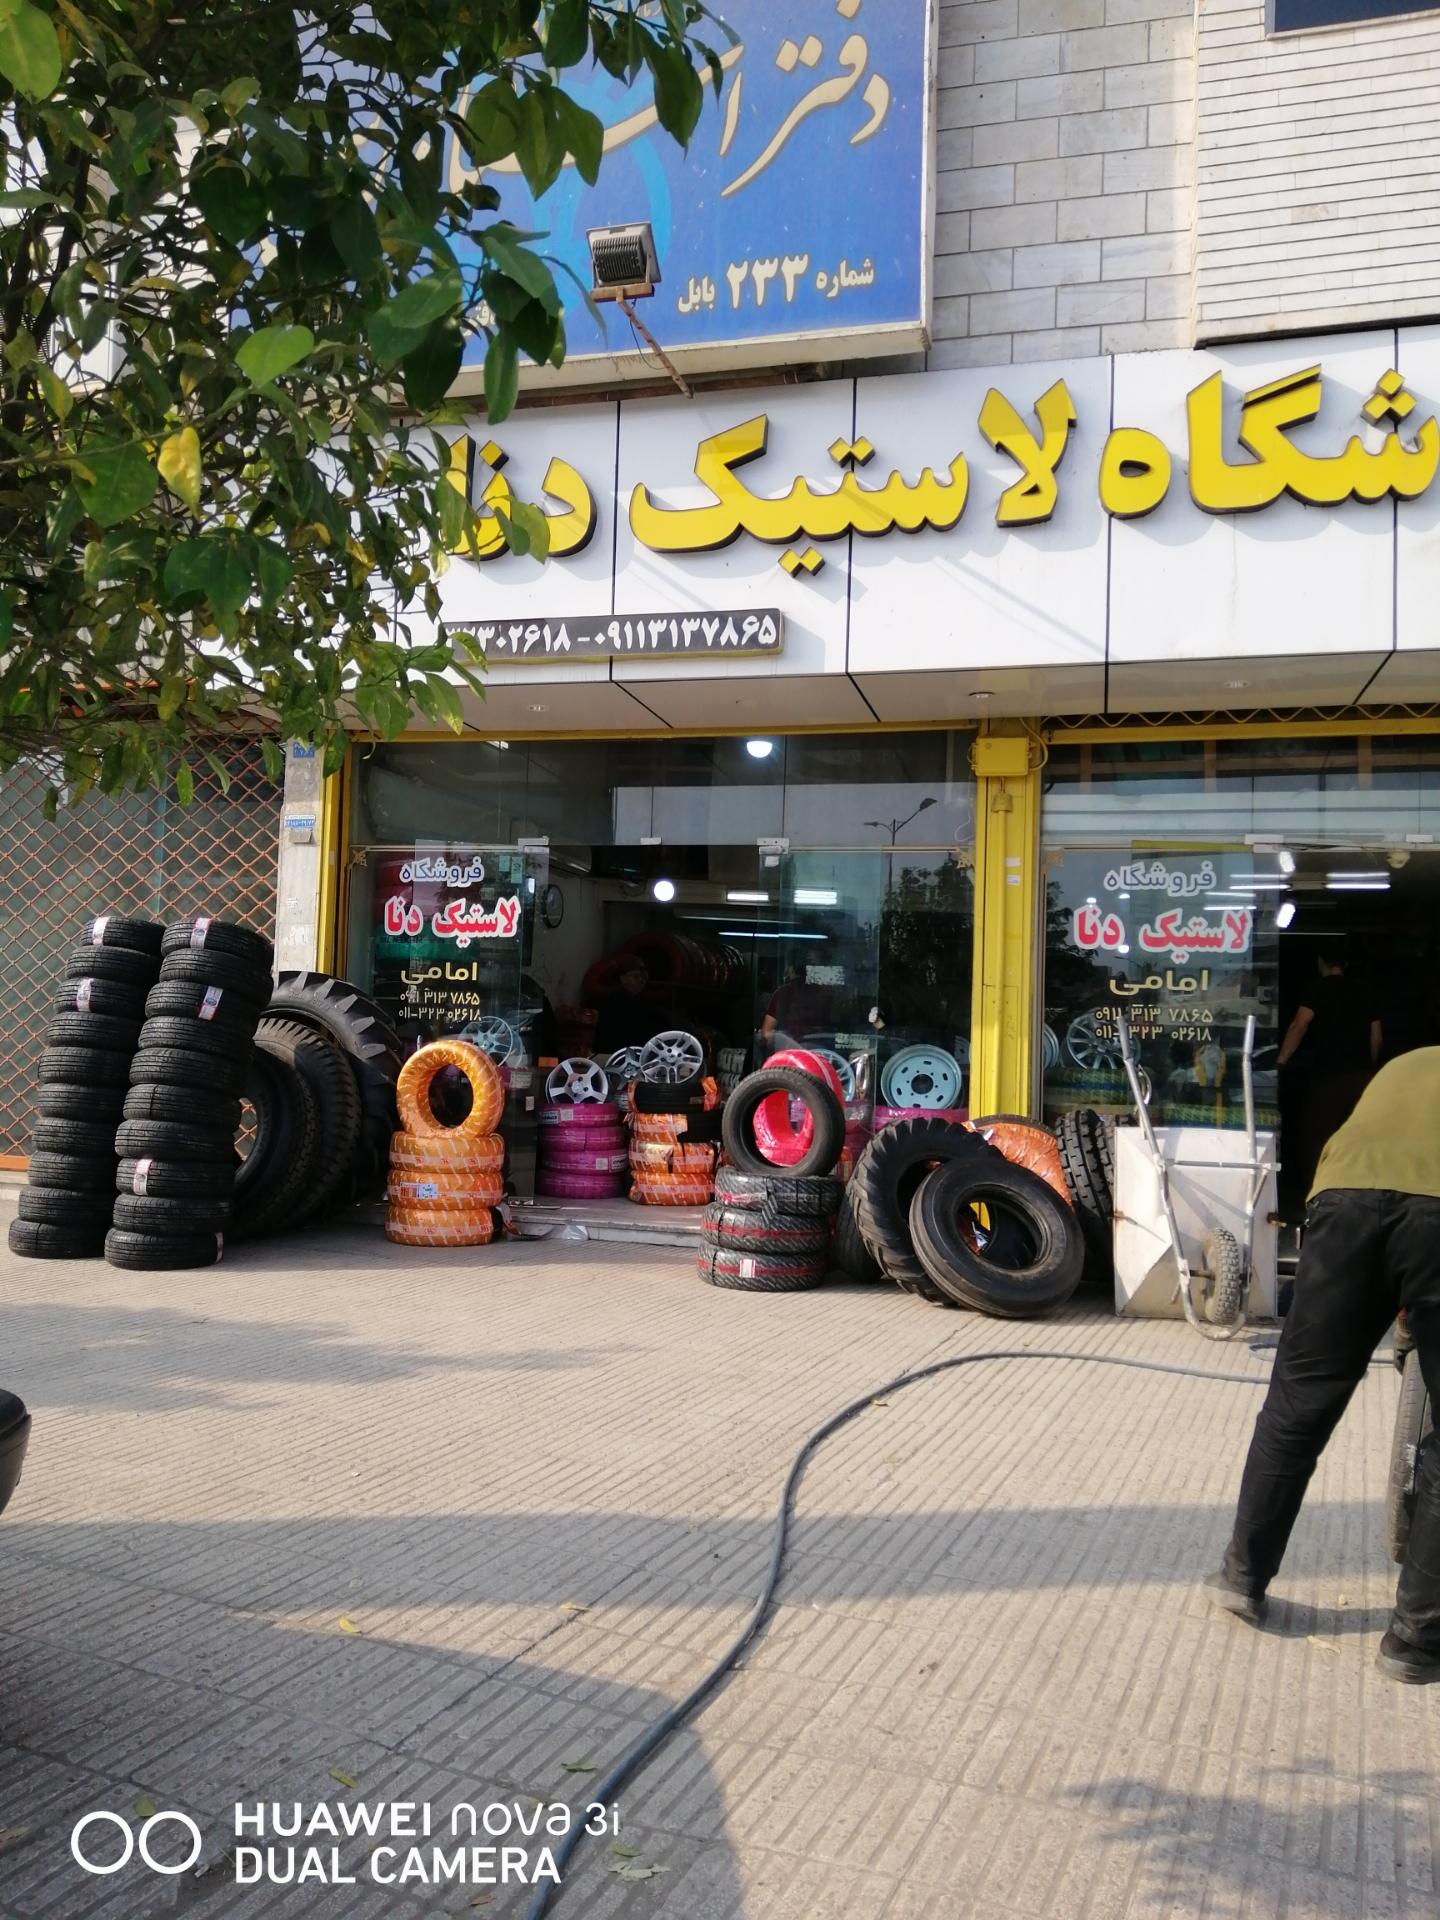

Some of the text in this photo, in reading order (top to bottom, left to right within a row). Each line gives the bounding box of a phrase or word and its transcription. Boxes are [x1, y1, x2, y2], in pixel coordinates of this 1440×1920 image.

[721, 0, 891, 198] دفتر
[678, 275, 715, 314] بابل
[815, 257, 875, 303] شماره
[629, 378, 1078, 578] لاستیک
[399, 855, 485, 888] فروشگاه
[1104, 860, 1217, 897] فروشگاه
[384, 895, 522, 948] لاستیک دنا
[1073, 904, 1252, 963] لاستیک دنا
[400, 961, 478, 985] امامی
[1109, 969, 1209, 996] امامی
